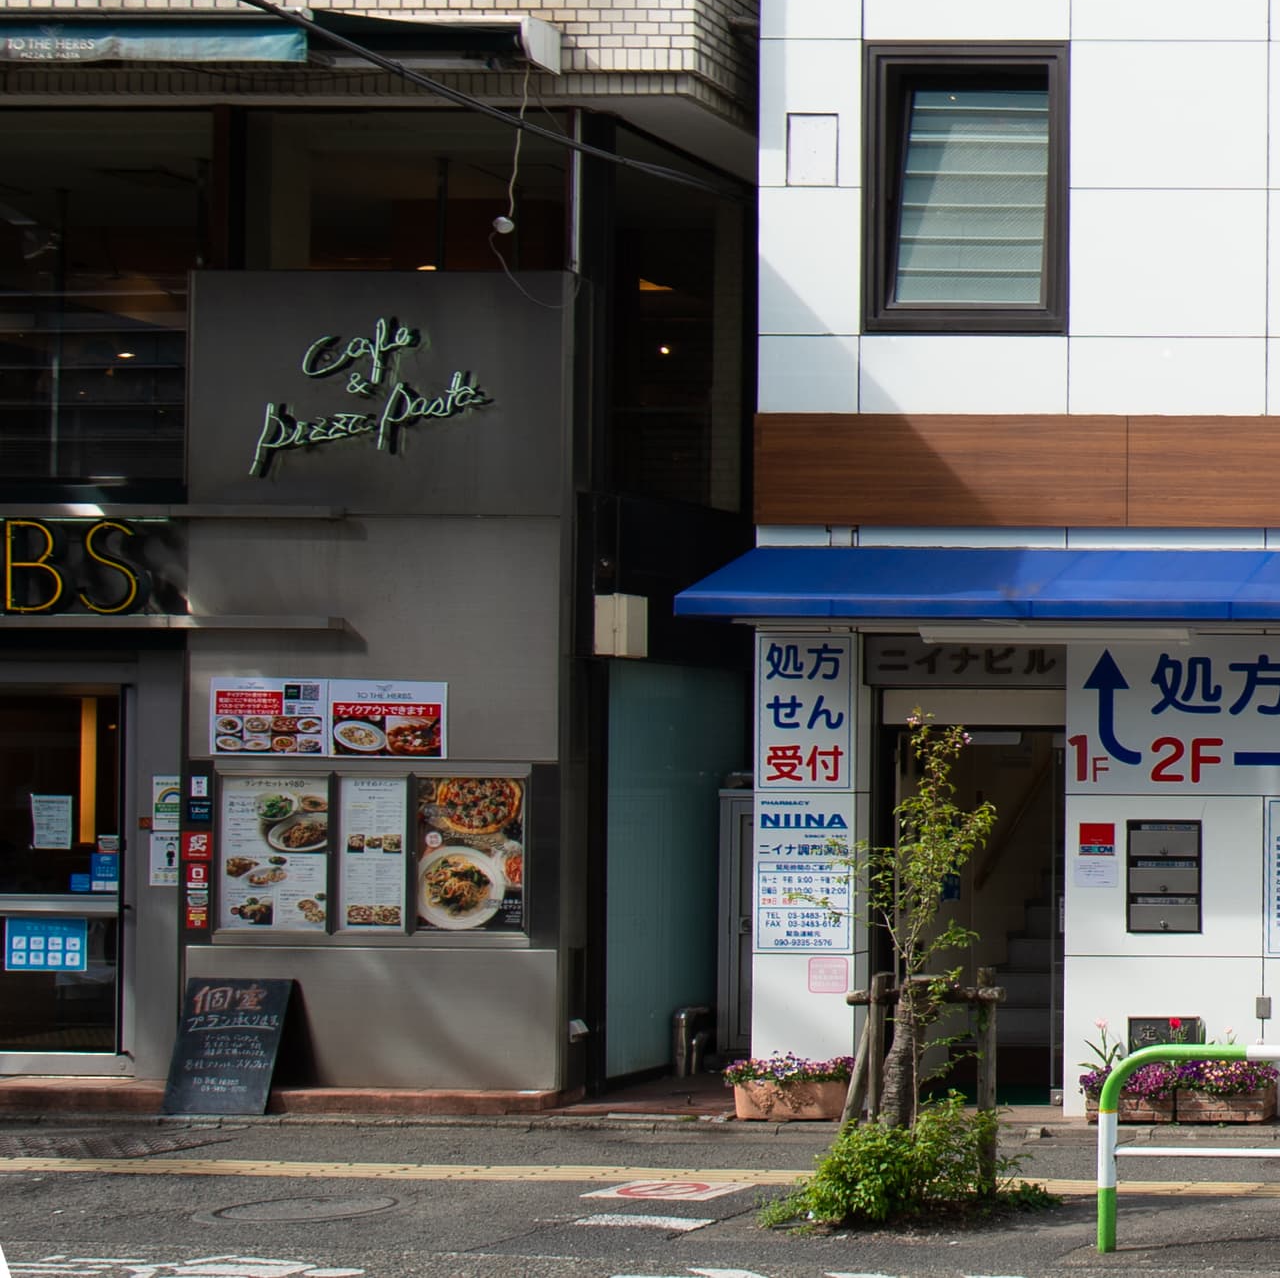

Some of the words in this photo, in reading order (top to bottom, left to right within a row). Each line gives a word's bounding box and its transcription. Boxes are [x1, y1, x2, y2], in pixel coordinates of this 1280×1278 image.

[766, 643, 844, 680] 処方
[878, 647, 1057, 675] ニイナビル
[766, 695, 844, 730] せん
[766, 745, 844, 782] 受付
[1151, 737, 1224, 784] 2F
[760, 813, 848, 829] NIINA
